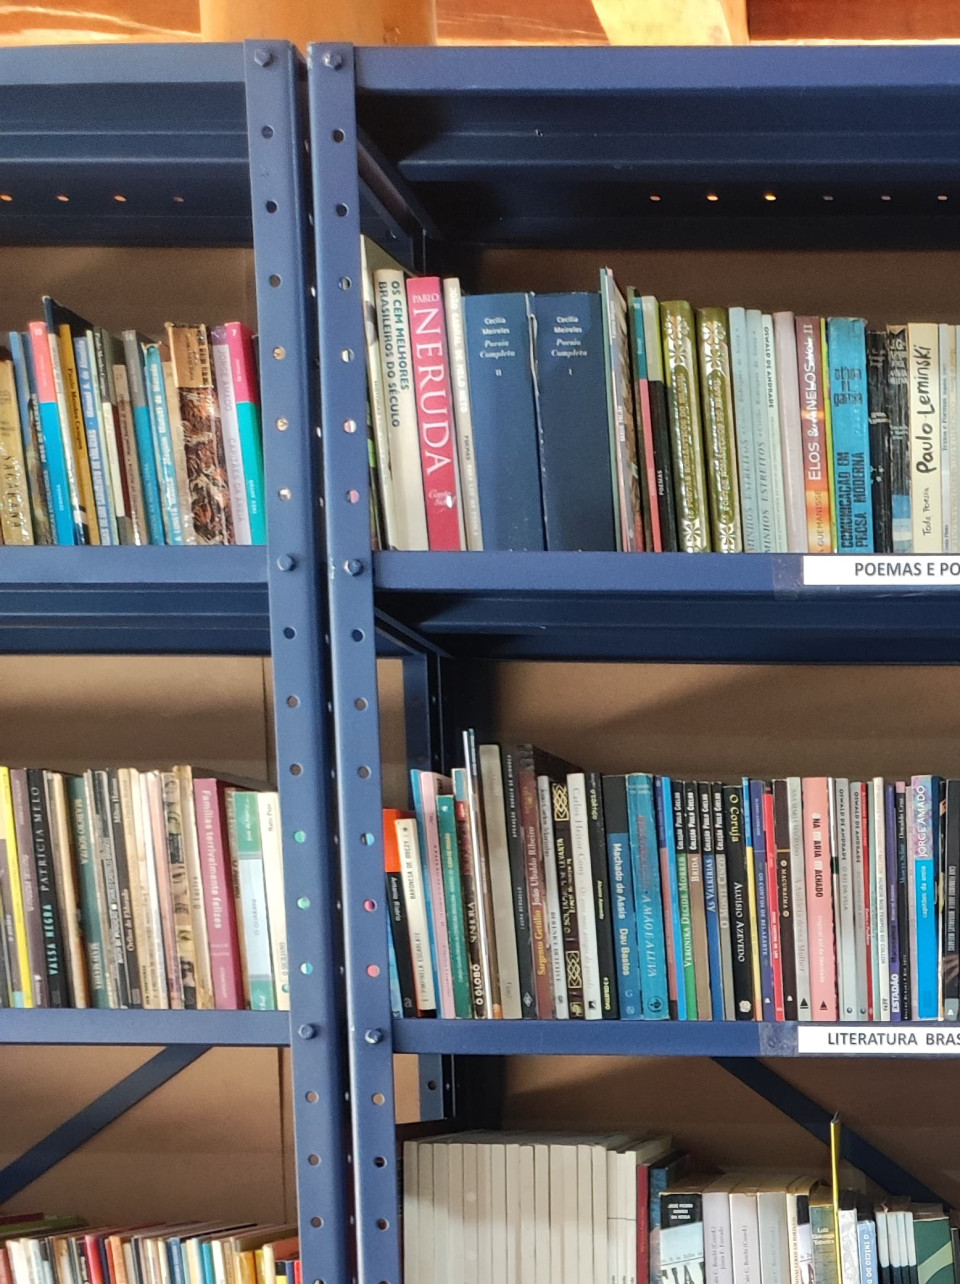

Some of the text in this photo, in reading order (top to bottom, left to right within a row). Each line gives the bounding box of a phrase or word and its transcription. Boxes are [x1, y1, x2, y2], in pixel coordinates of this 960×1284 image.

[413, 293, 439, 303] PABLO
[378, 280, 402, 427] BRASILEIROS DO SÉCULO
[391, 280, 409, 390] OS CEM MELHORES
[412, 306, 453, 474] NERUDA
[913, 344, 936, 473] Paulo Leminski
[852, 452, 867, 547] PROSA MODERNA
[855, 562, 921, 576] POEMAS
[927, 563, 934, 576] E
[30, 786, 49, 891] PATRÍCIA MELO
[728, 794, 740, 842] O Coruja
[916, 785, 928, 856] JORGE AMADO
[526, 826, 547, 975] Sargento Getúlio João Ubaldo Ribeiro
[612, 843, 627, 918] Machado de Assis
[42, 904, 58, 974] VALSA NEGRA
[619, 928, 631, 975] Dau Bastos
[472, 964, 482, 996] GLOBO
[890, 973, 899, 1012] ESTADÃO
[828, 1032, 917, 1045] LITERATURA
[863, 1241, 873, 1266] INÍCIO
[865, 1268, 872, 1277] DO
